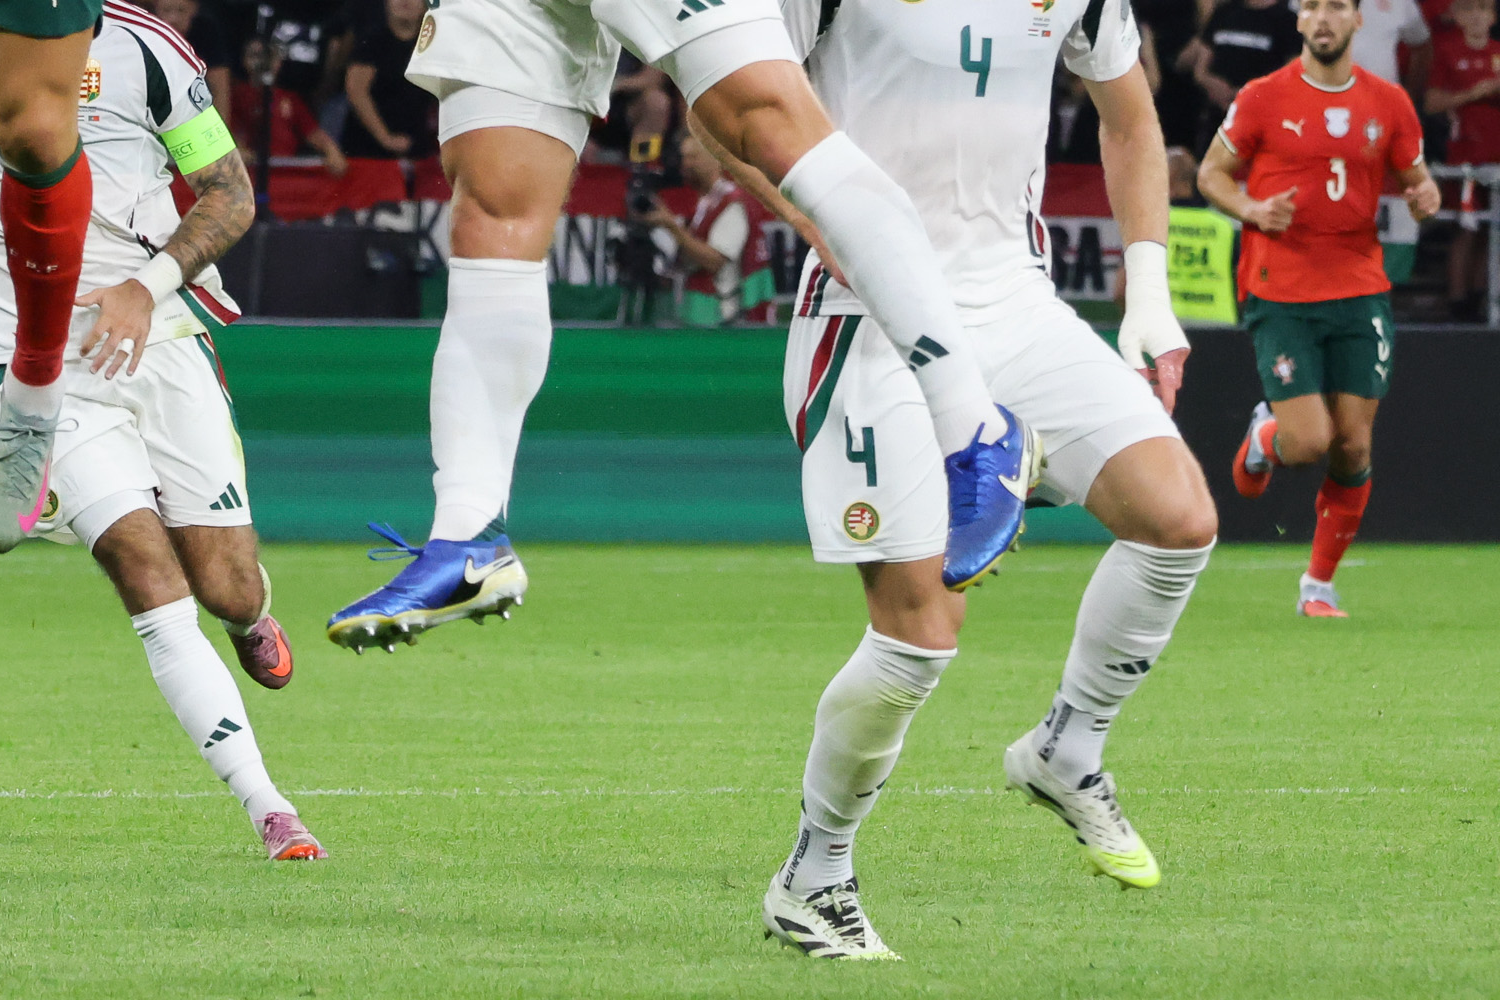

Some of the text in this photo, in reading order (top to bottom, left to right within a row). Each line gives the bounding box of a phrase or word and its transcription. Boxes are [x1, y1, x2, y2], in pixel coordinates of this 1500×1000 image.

[960, 24, 992, 98] 4
[1325, 157, 1348, 202] 3
[845, 416, 878, 488] 4
